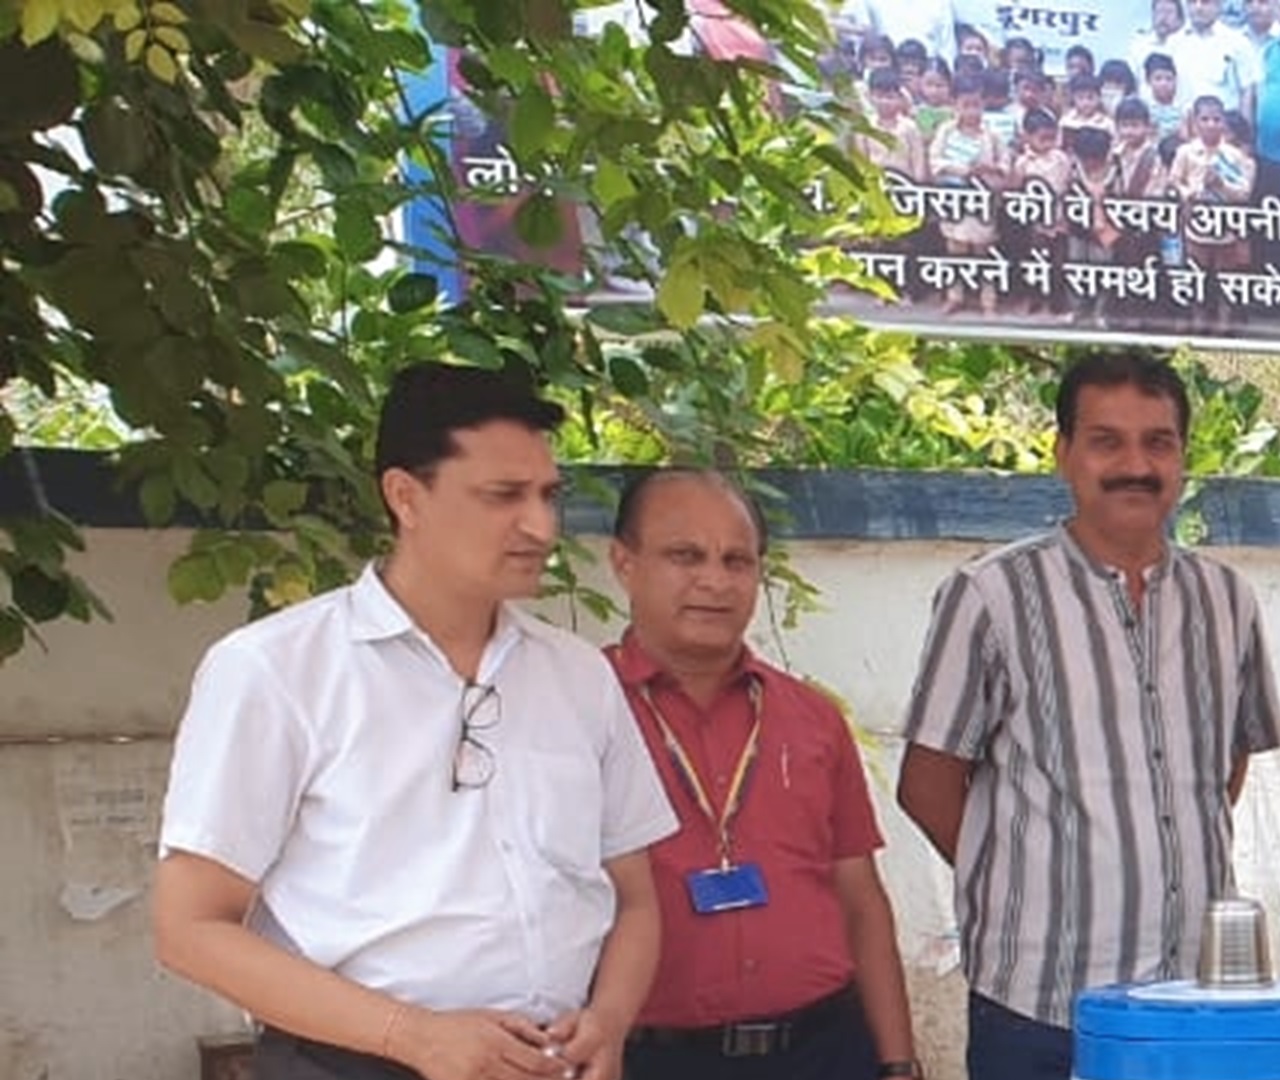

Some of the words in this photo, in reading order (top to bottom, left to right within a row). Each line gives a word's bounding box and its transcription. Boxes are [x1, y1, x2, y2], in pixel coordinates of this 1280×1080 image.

[1004, 181, 1054, 226] की
[1065, 182, 1091, 228] वे
[917, 246, 1010, 292] करने
[1020, 248, 1051, 294] में
[1063, 257, 1158, 300] समर्थ
[1167, 259, 1206, 305] हो
